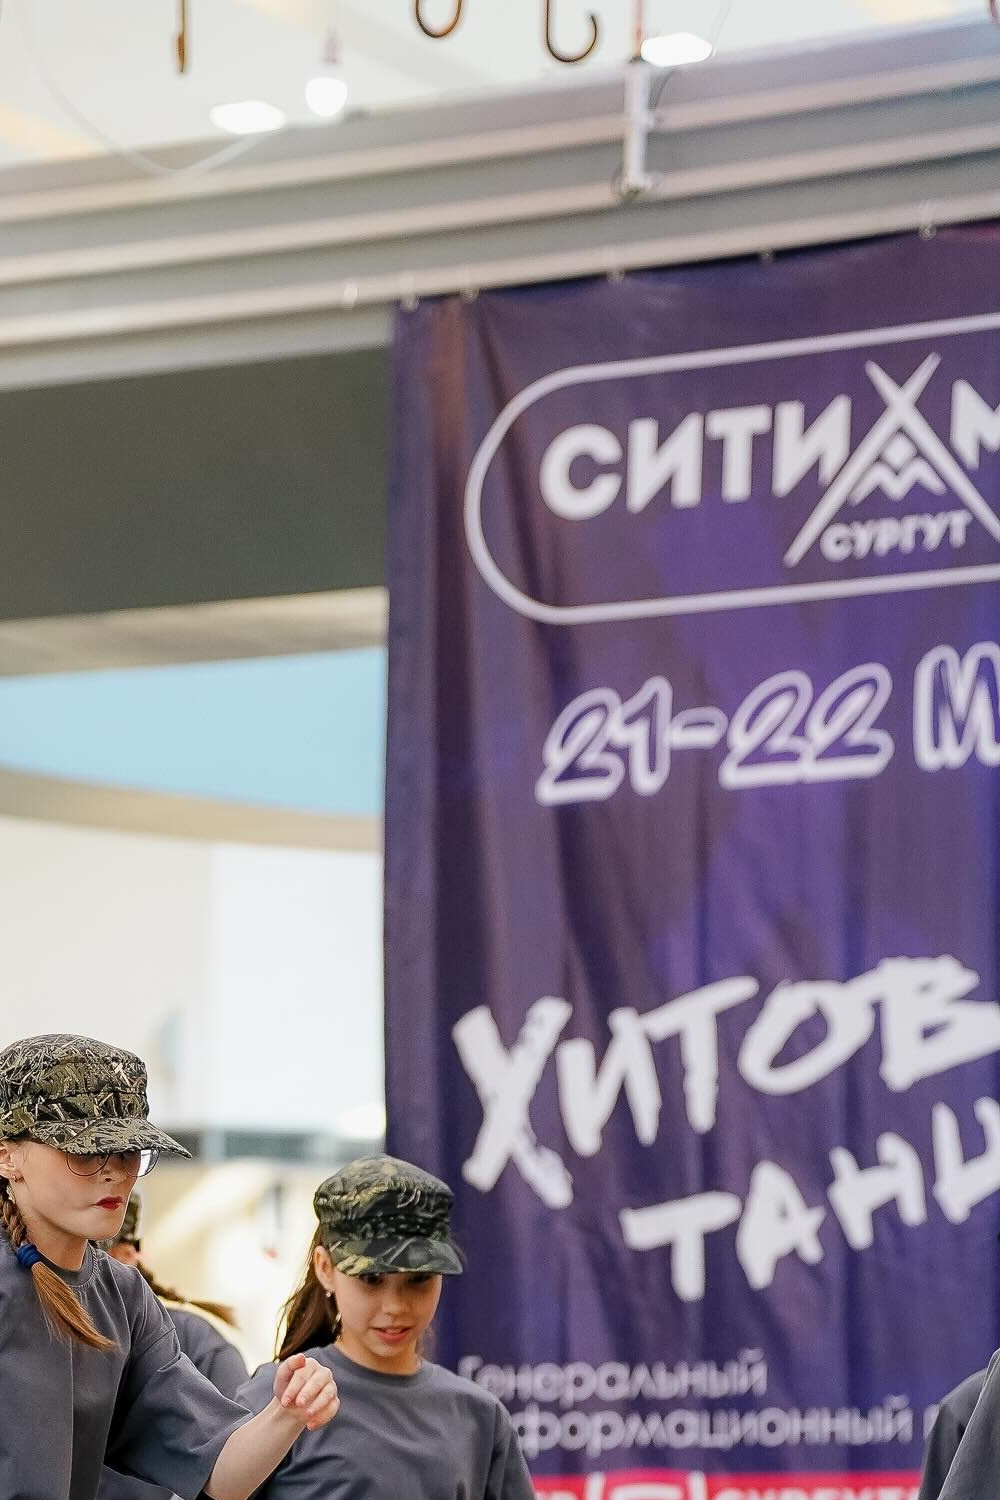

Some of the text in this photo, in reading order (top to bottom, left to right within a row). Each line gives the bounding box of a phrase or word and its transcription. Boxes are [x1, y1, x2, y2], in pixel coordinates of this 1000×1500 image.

[538, 393, 853, 522] СИТИ
[819, 508, 973, 563] СУРГУТ
[534, 661, 896, 808] 21-22
[457, 1348, 768, 1408] Генеральный
[512, 1394, 913, 1459] формационный
